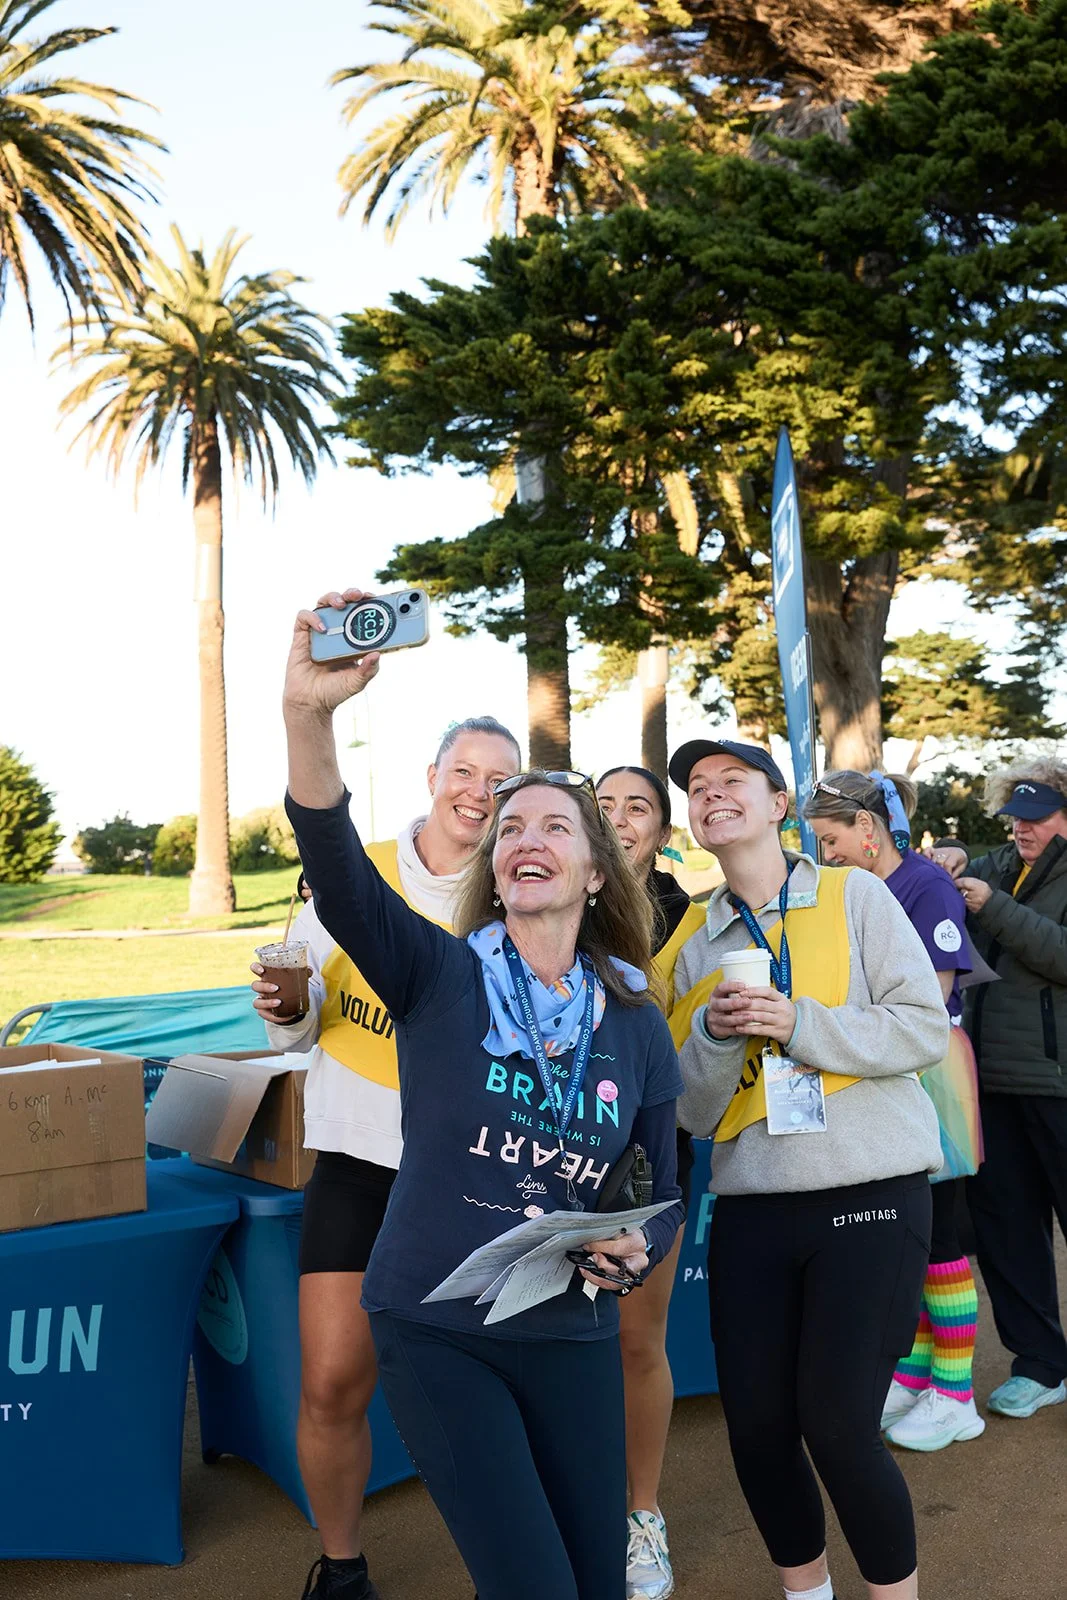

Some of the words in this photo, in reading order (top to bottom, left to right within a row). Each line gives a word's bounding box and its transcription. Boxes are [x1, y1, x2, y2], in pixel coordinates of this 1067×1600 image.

[364, 610, 377, 640] RCD
[515, 977, 534, 1025] FOUNDATION
[530, 1025, 542, 1051] DAWES
[578, 1030, 590, 1061] CONNOR
[537, 1052, 551, 1086] CONNOR
[572, 1062, 583, 1086] DAWES
[8, 1091, 18, 1111] 6
[485, 1061, 620, 1129] BRAIN
[560, 1087, 577, 1130] FOUNDATIO
[510, 1111, 533, 1127] THE
[589, 1135, 601, 1147] IS
[468, 1126, 610, 1190] HEART
[848, 1208, 898, 1224] TWOTAGS
[683, 1266, 709, 1282] PA
[8, 1304, 104, 1375] UN
